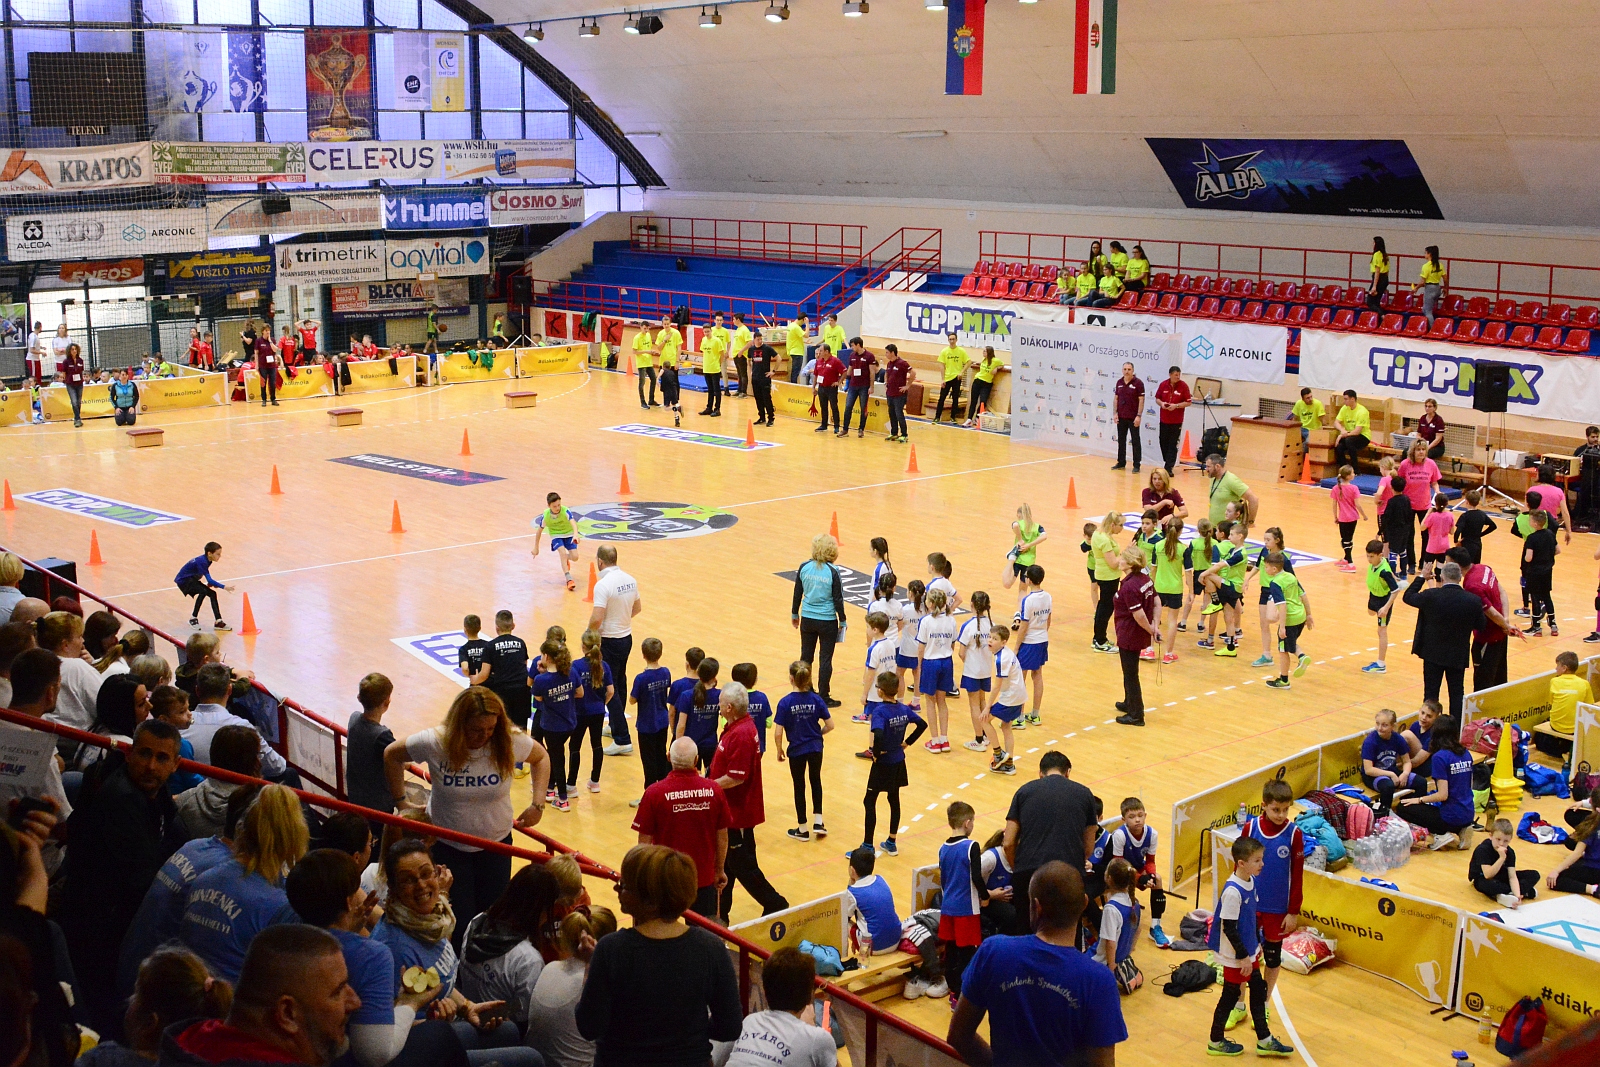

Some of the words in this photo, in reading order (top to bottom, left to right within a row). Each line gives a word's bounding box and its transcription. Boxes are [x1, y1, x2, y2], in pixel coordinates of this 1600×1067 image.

[70, 125, 106, 136] TELENIT
[443, 140, 498, 151] www.WSH.hu
[58, 155, 142, 183] KRATOS
[153, 161, 173, 174] GYEP
[285, 161, 305, 174] GYEP
[1198, 167, 1266, 199] ALBA
[561, 194, 583, 209] Sport
[151, 228, 196, 237] ARCONIC
[17, 241, 52, 250] ALCOA
[296, 245, 378, 263] trimetrik
[390, 240, 466, 273] aqvital
[71, 266, 132, 281] ENEOS
[233, 264, 271, 276] TRANSZ
[368, 282, 425, 299] BLECHA
[1020, 335, 1079, 352] DIÁKOLIMPIA
[1088, 343, 1129, 358] Országos
[1131, 348, 1160, 361] Döntő
[1219, 347, 1273, 363] ARCONIC
[1368, 346, 1544, 407] TiPPMX
[349, 453, 458, 477] WELLSTAR
[929, 632, 953, 640] HUNYADI
[548, 681, 574, 696] ZRÍNYI
[665, 787, 715, 801] VERSENYBÍRÓ
[1298, 907, 1385, 942] iakolimpia
[1399, 906, 1454, 929] @diakolimpia
[736, 1032, 792, 1058] ÓVÁROS
